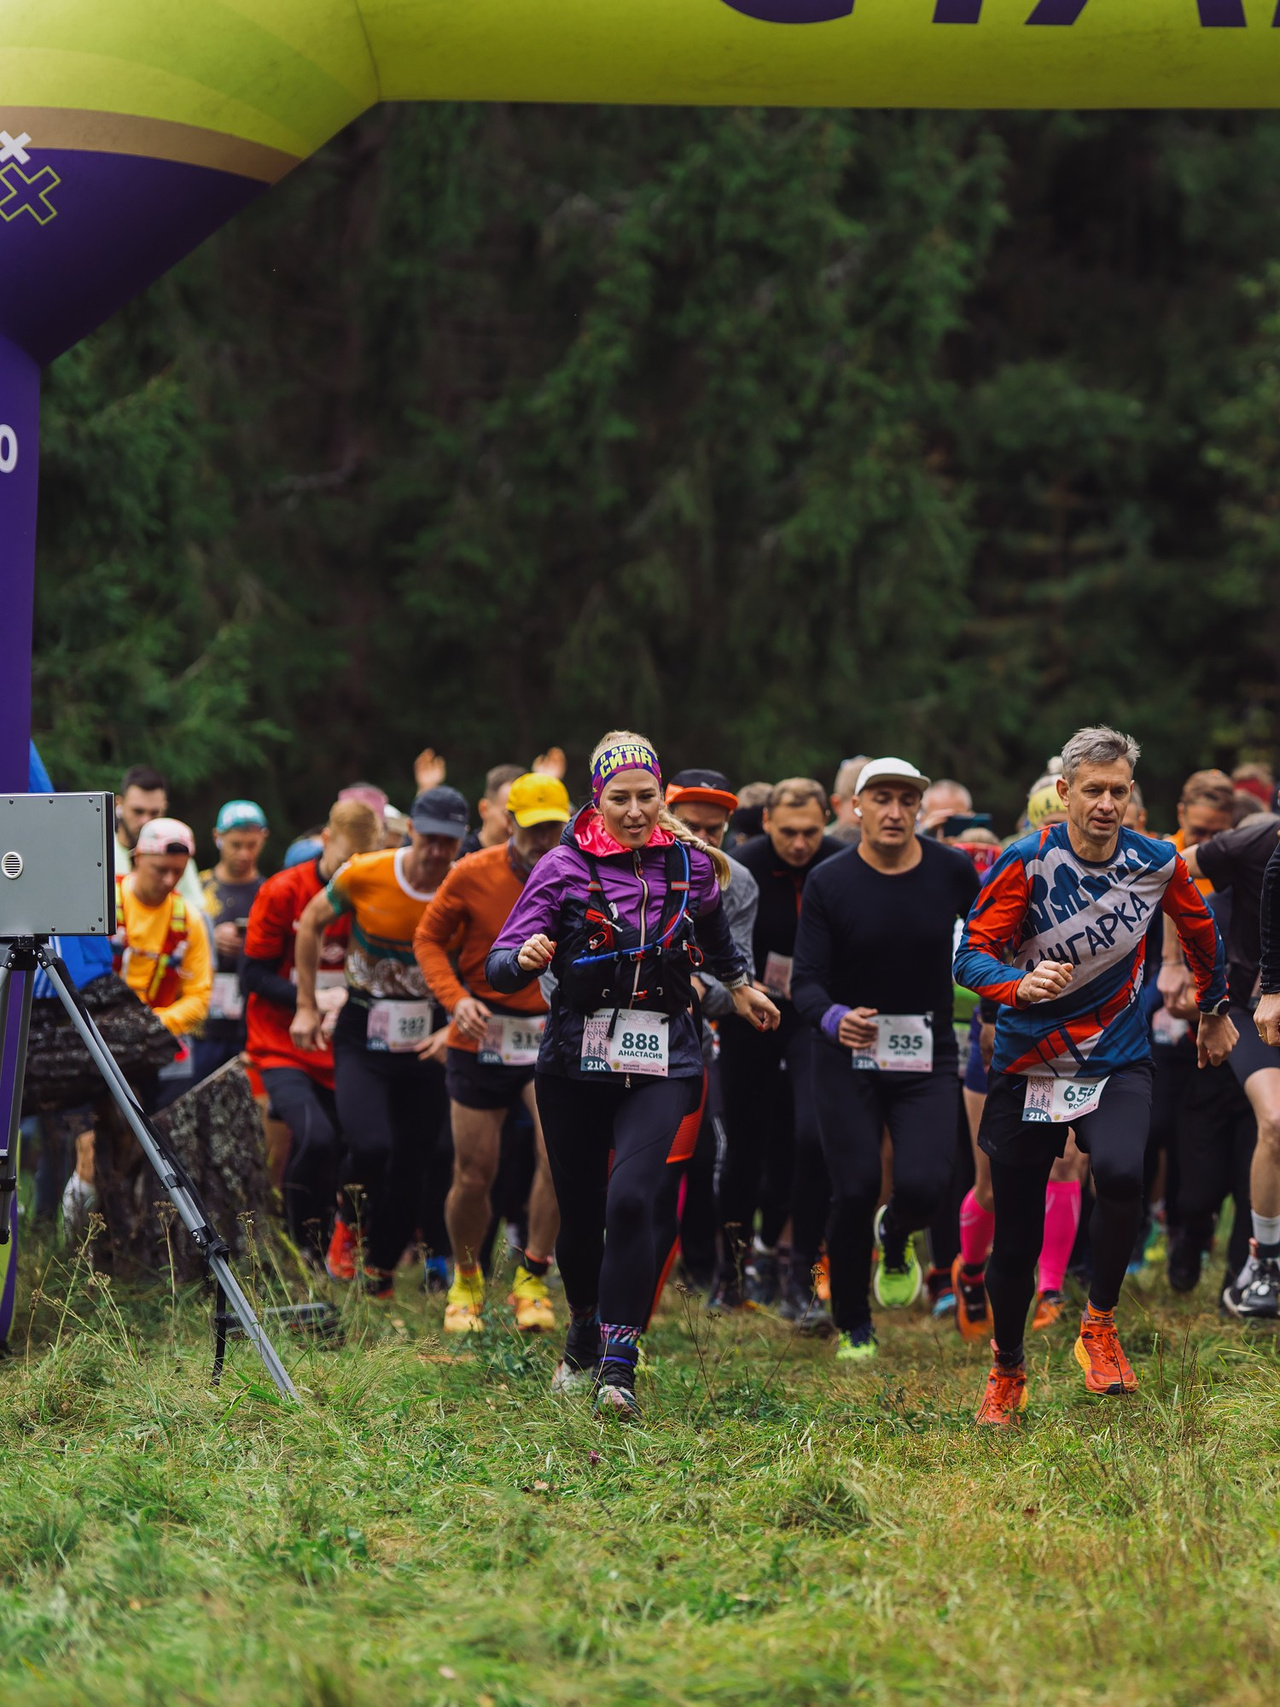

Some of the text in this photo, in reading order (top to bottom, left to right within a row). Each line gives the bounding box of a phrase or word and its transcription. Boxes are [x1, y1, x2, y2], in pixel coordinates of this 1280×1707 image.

[599, 751, 652, 779] СИЛА
[621, 1032, 660, 1051] 888
[888, 1035, 923, 1050] 535
[618, 1049, 663, 1060] АНАСТАСИЯ
[1063, 1085, 1098, 1102] 658
